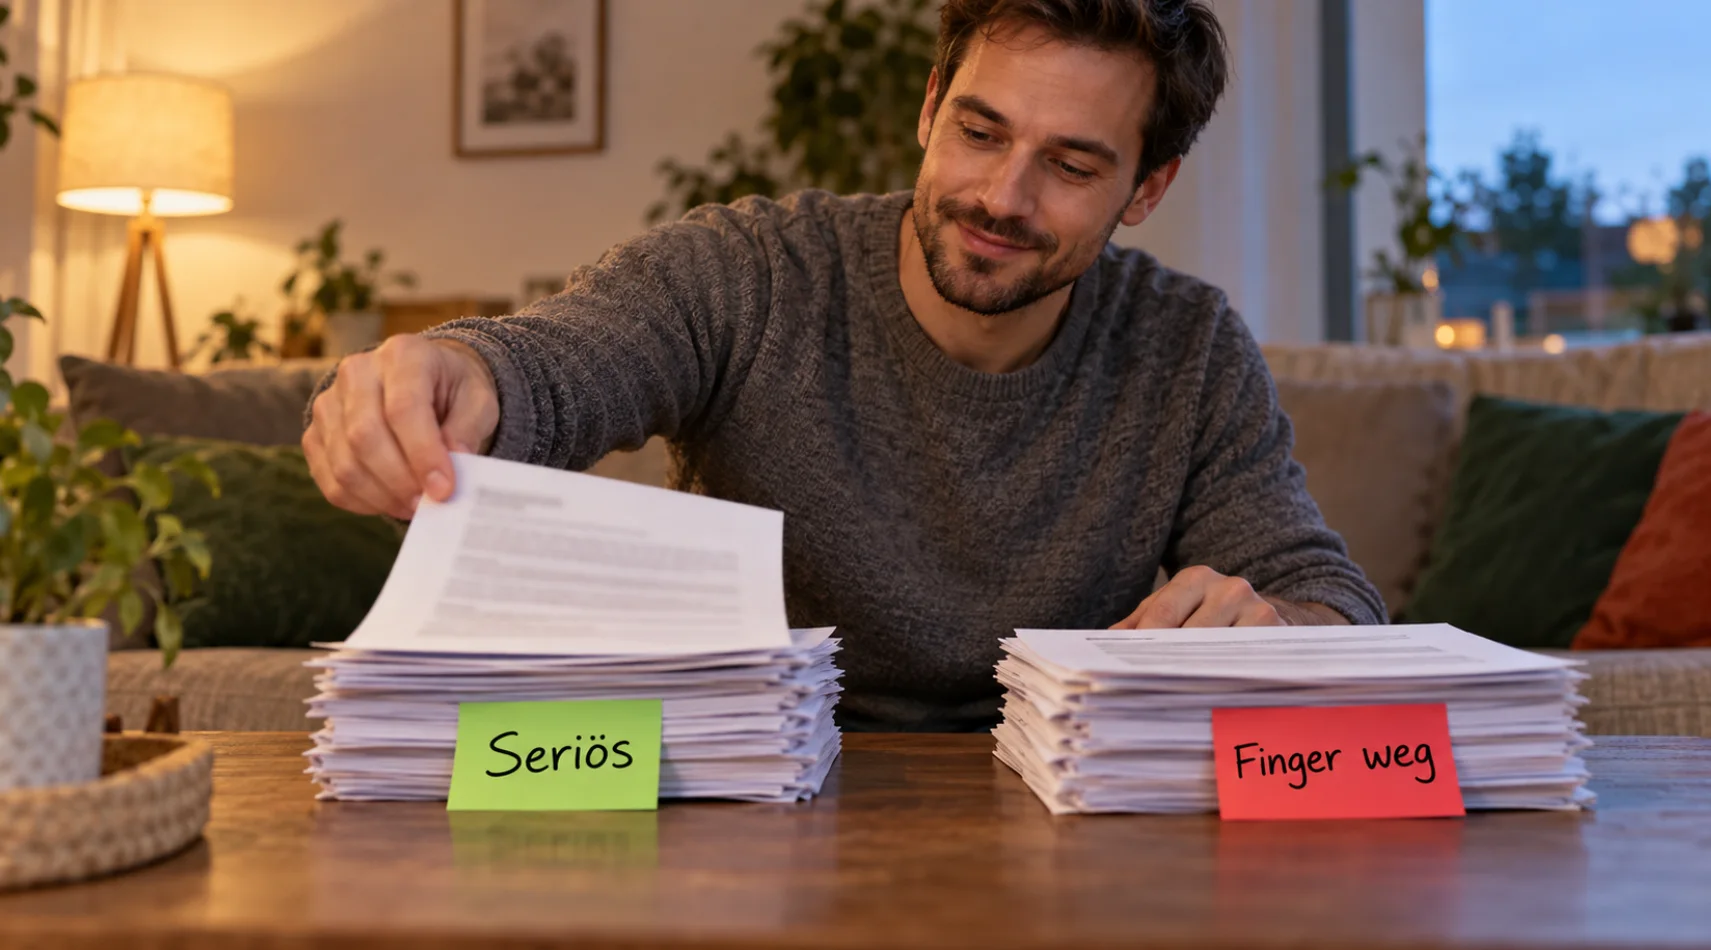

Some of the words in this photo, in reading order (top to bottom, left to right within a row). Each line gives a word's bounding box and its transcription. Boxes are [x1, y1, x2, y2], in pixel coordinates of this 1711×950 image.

[486, 731, 633, 777] Seriös
[1233, 742, 1342, 790] Finger
[1363, 744, 1436, 785] weg
